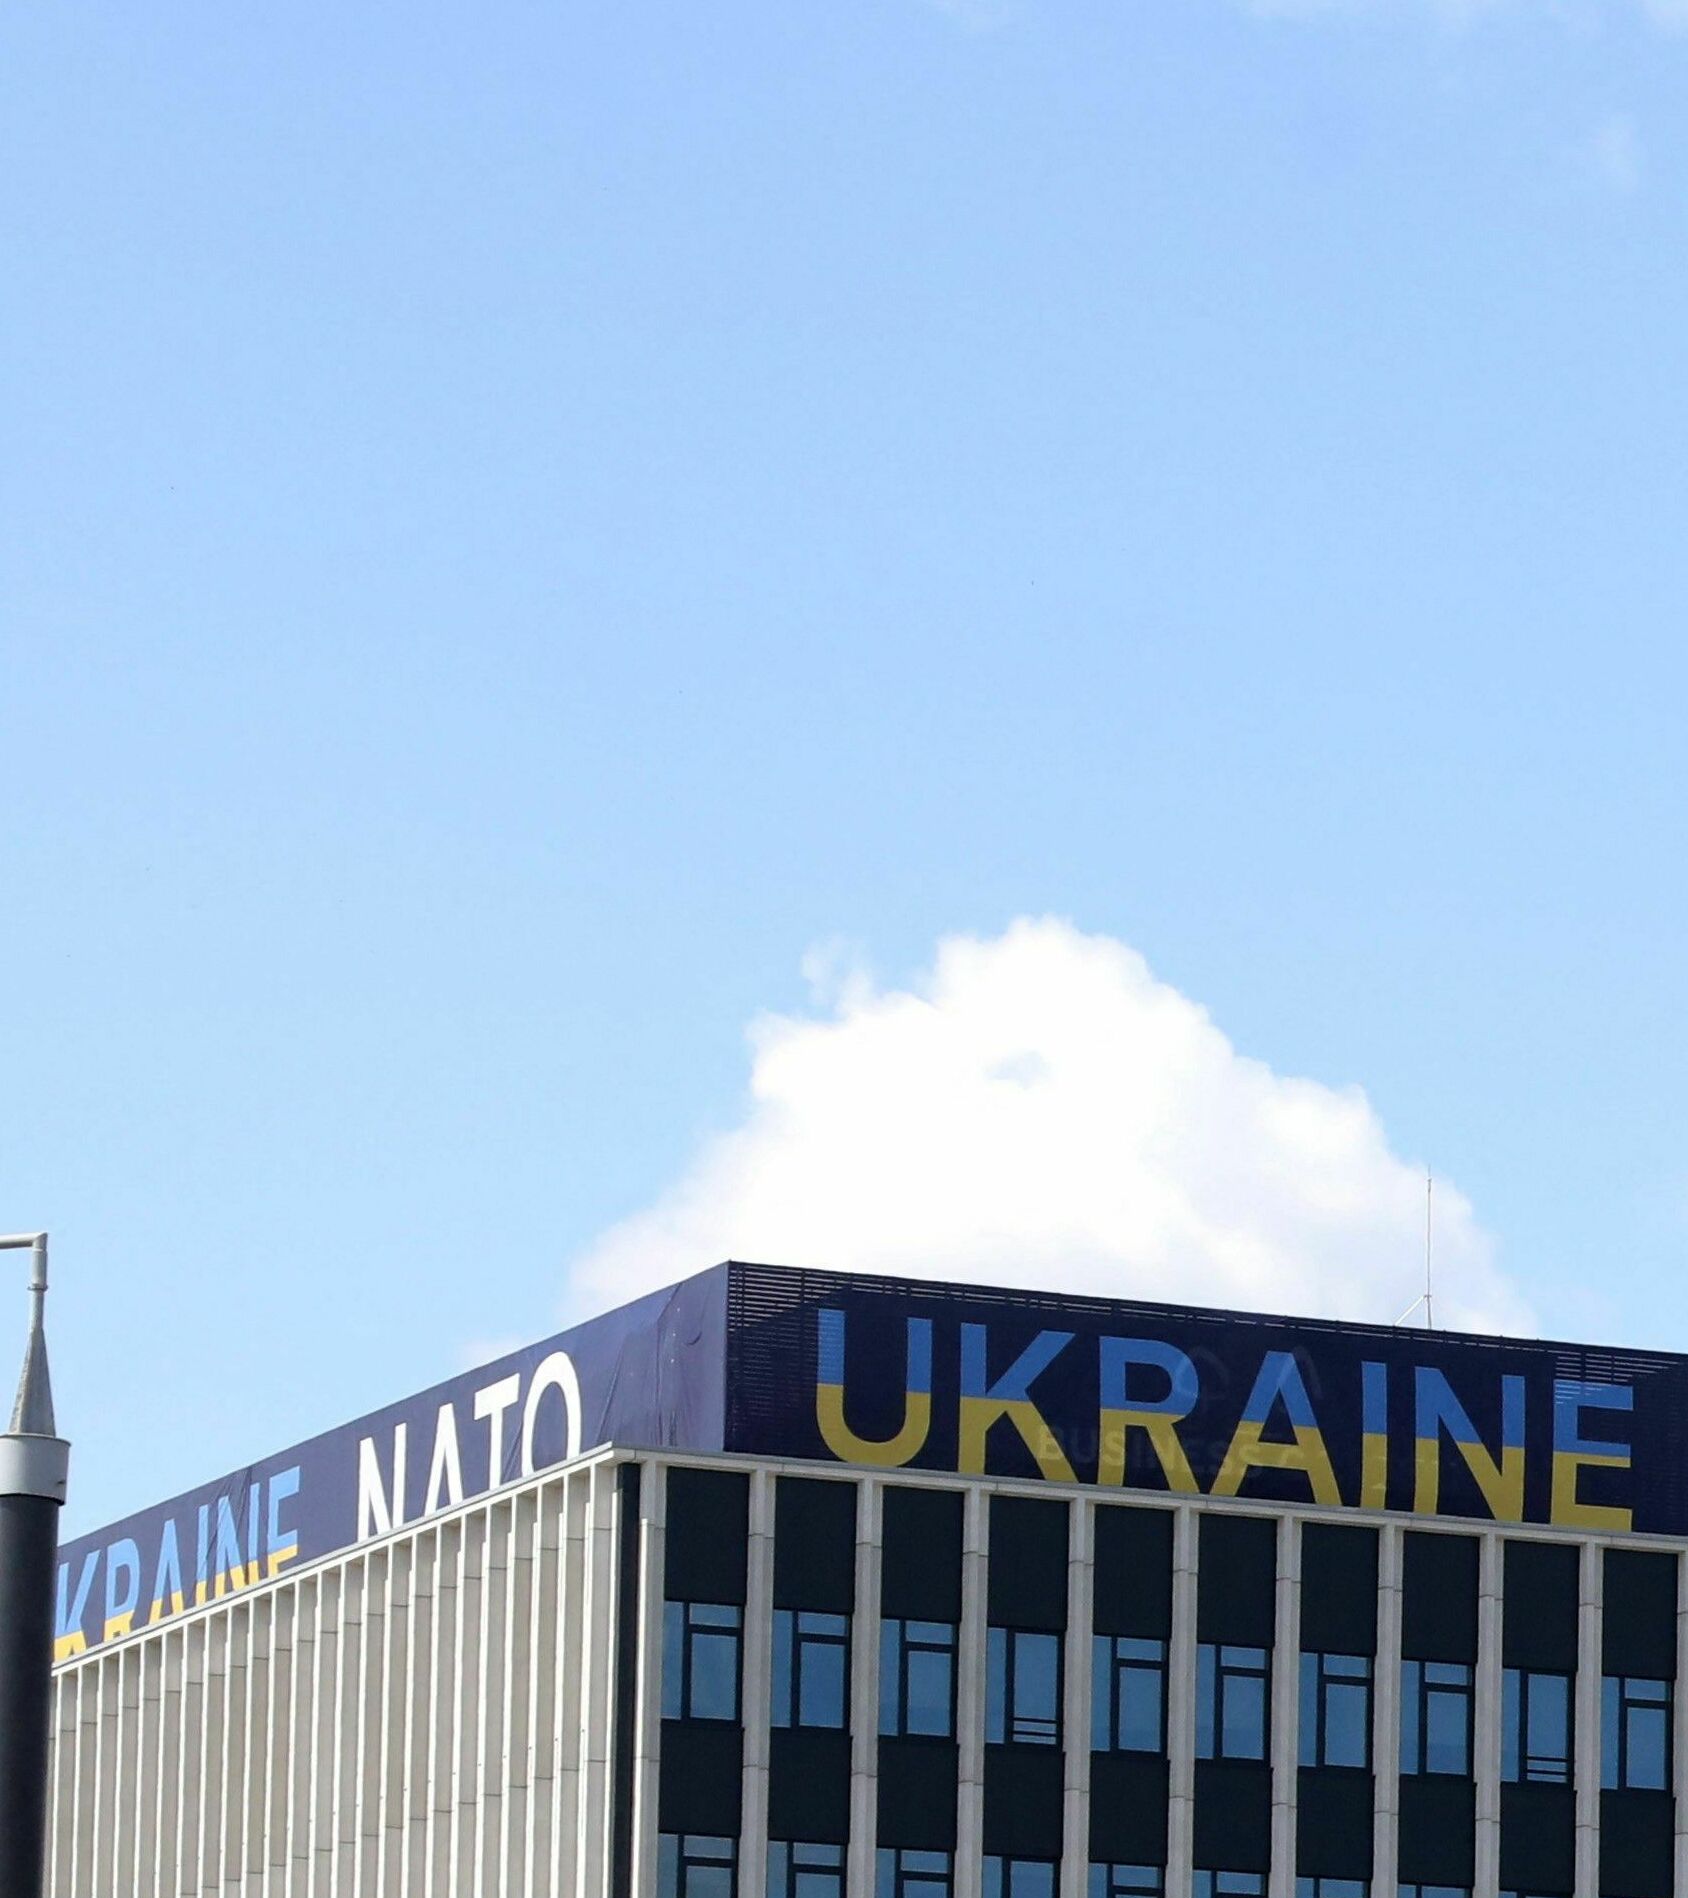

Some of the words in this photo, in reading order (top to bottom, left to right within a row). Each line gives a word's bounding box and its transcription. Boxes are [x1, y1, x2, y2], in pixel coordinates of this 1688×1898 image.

[54, 1466, 300, 1663] KRAINE
[358, 1351, 582, 1542] NATO
[816, 1308, 1634, 1532] UKRAINE
